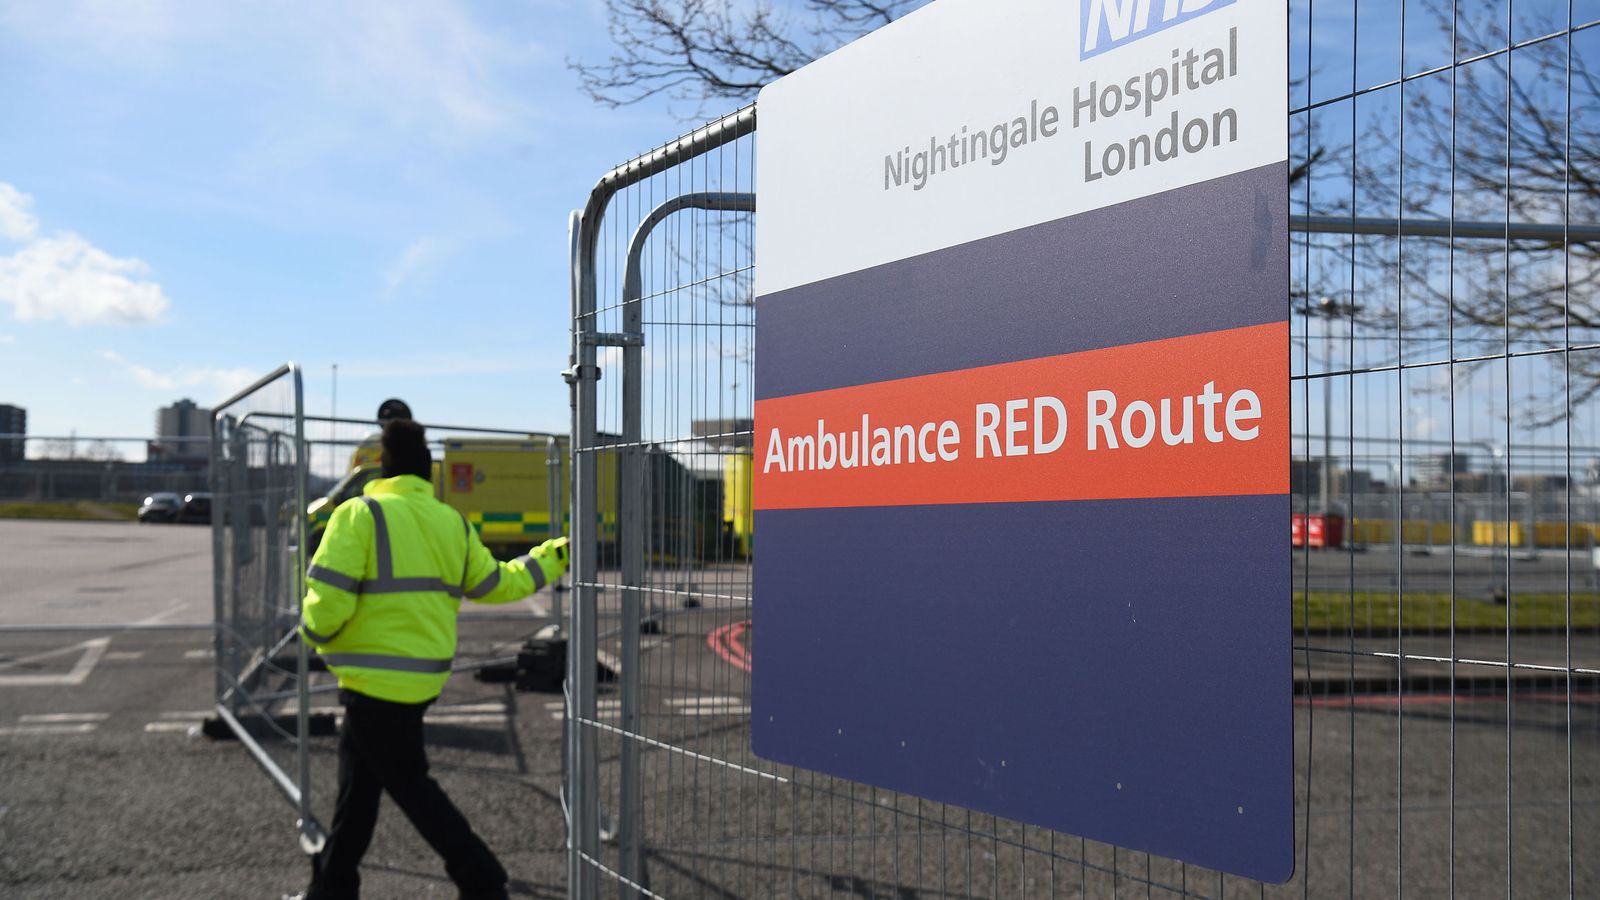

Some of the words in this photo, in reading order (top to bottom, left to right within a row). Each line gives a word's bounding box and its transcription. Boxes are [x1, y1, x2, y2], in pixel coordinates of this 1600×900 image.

[884, 99, 1060, 191] Nightingale
[1072, 26, 1238, 128] Hospital
[1084, 107, 1238, 183] London
[763, 414, 960, 474] Ambulance
[975, 395, 1068, 459] RED
[1087, 380, 1263, 451] Route
